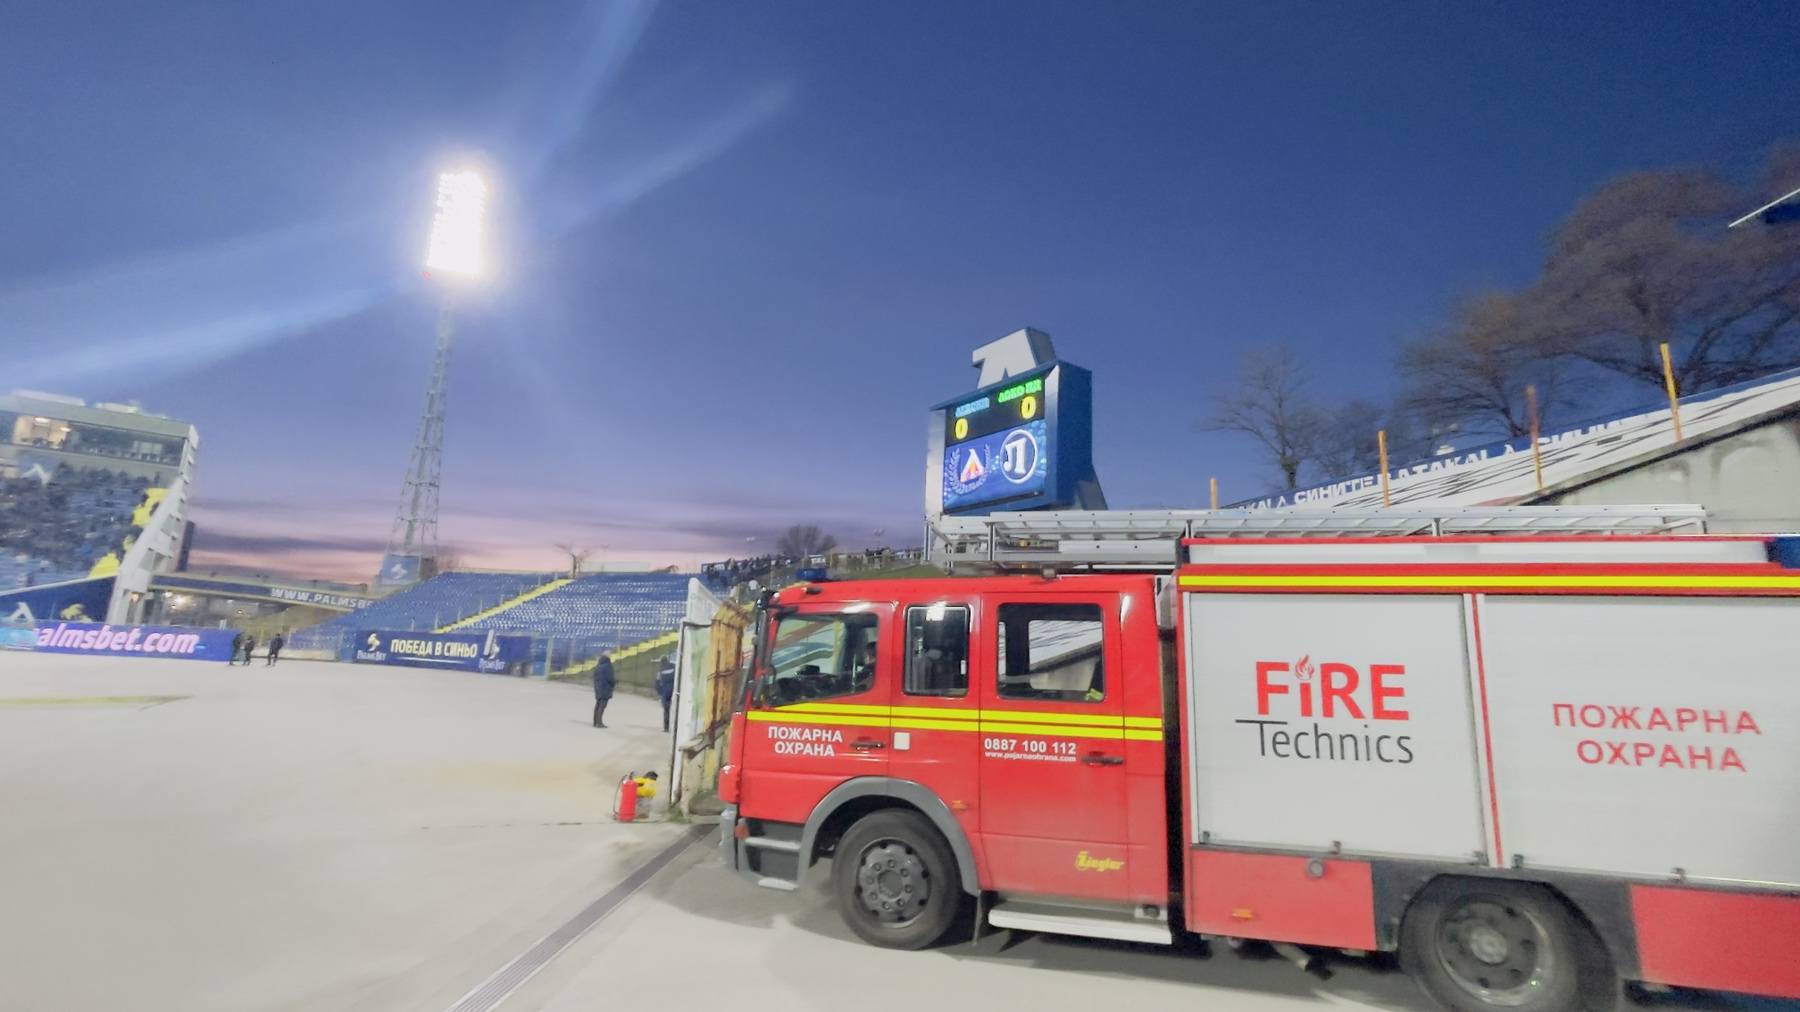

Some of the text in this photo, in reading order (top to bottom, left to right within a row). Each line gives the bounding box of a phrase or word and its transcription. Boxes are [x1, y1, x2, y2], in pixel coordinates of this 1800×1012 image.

[1021, 396, 1036, 420] 0
[955, 418, 968, 440] 0
[390, 639, 479, 658] ПОБЕДА В СИНЬО
[1553, 703, 1761, 736] ПОЖАРНА
[768, 726, 843, 744] ПОЖАРНА
[1235, 719, 1414, 765] Technics
[774, 741, 835, 758] ОХРАНА
[984, 738, 1077, 755] 0887 100 112
[1577, 740, 1747, 773] ОХРАНА
